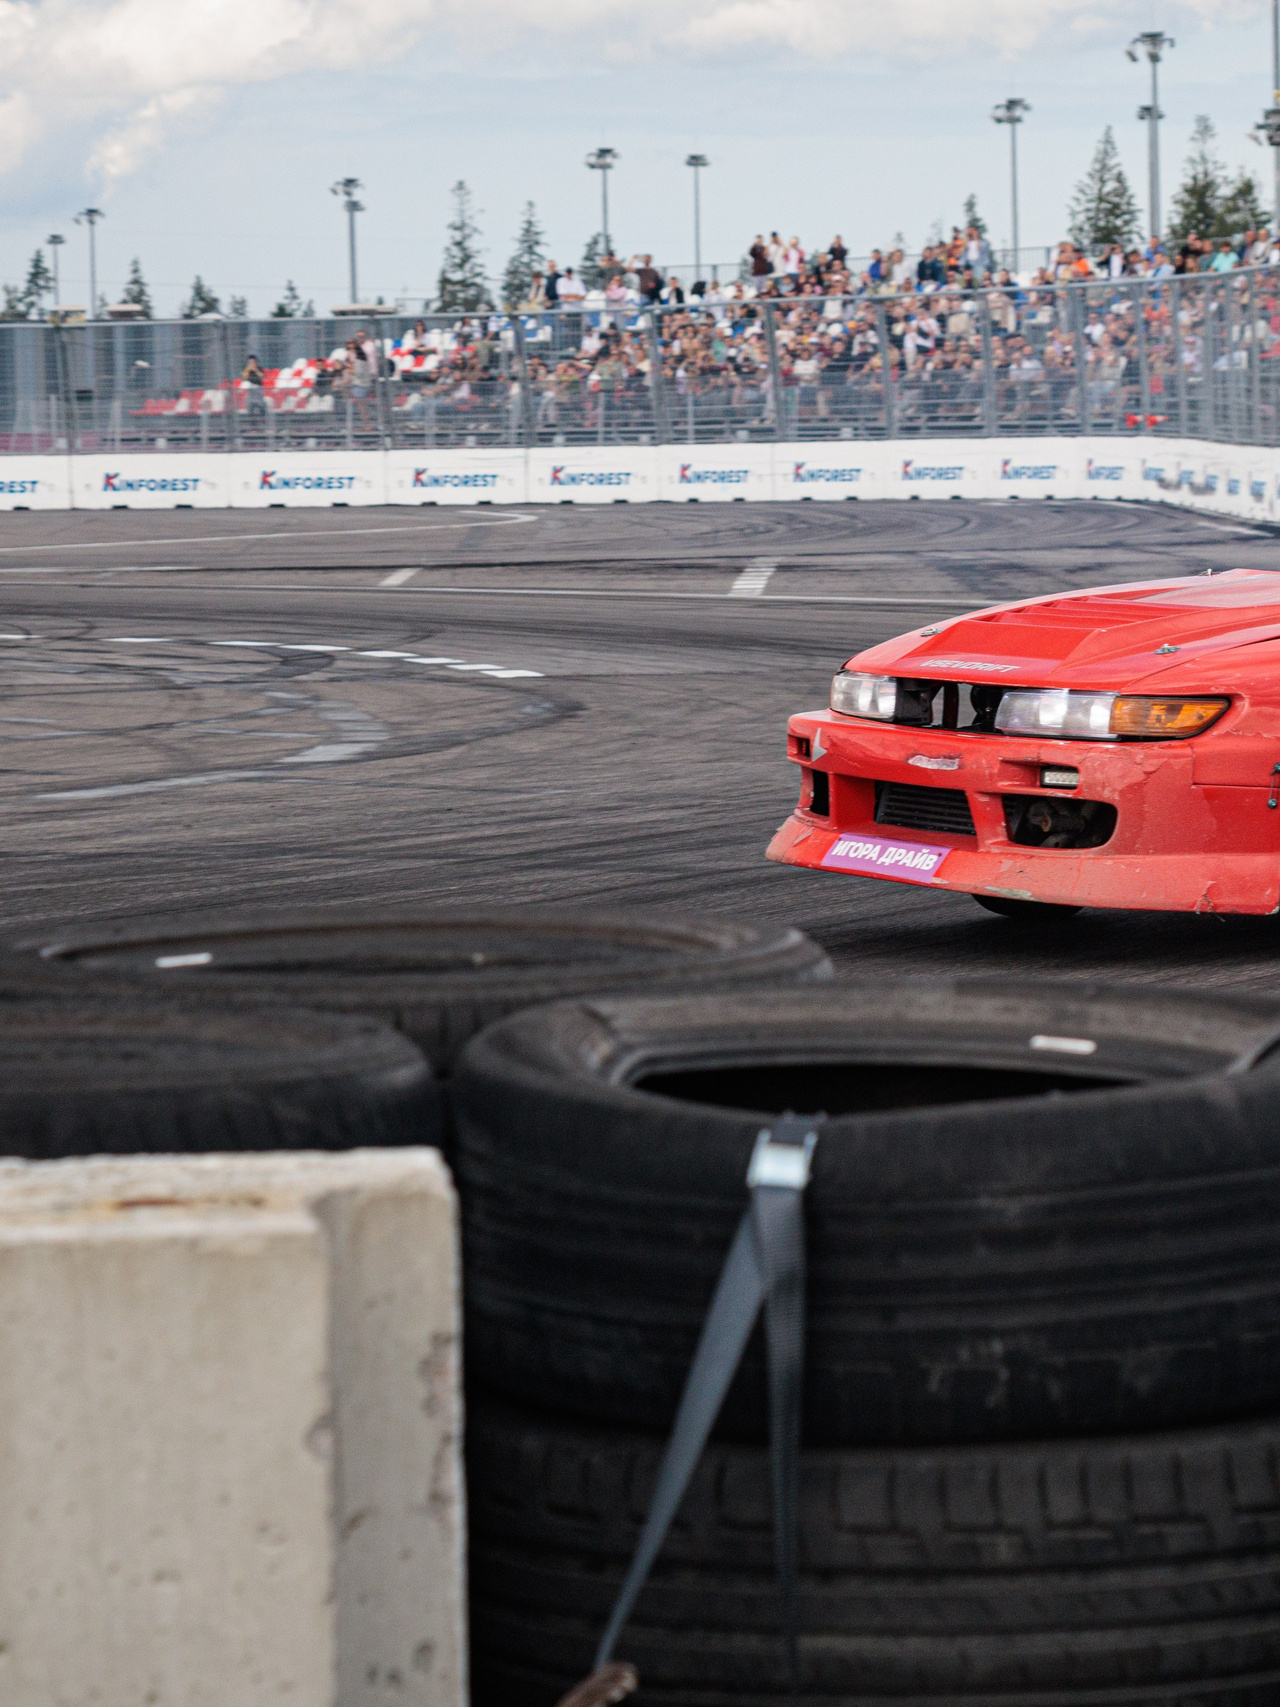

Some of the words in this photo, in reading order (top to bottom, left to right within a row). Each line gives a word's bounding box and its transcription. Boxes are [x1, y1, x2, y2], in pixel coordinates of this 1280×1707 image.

[102, 471, 201, 492] KINFOREST
[259, 469, 356, 491] KINFOREST
[413, 467, 499, 489] KINFOREST
[550, 465, 632, 486] KINFOREST
[831, 840, 882, 862] ИГОРА
[876, 846, 939, 871] ДРАЙВ
